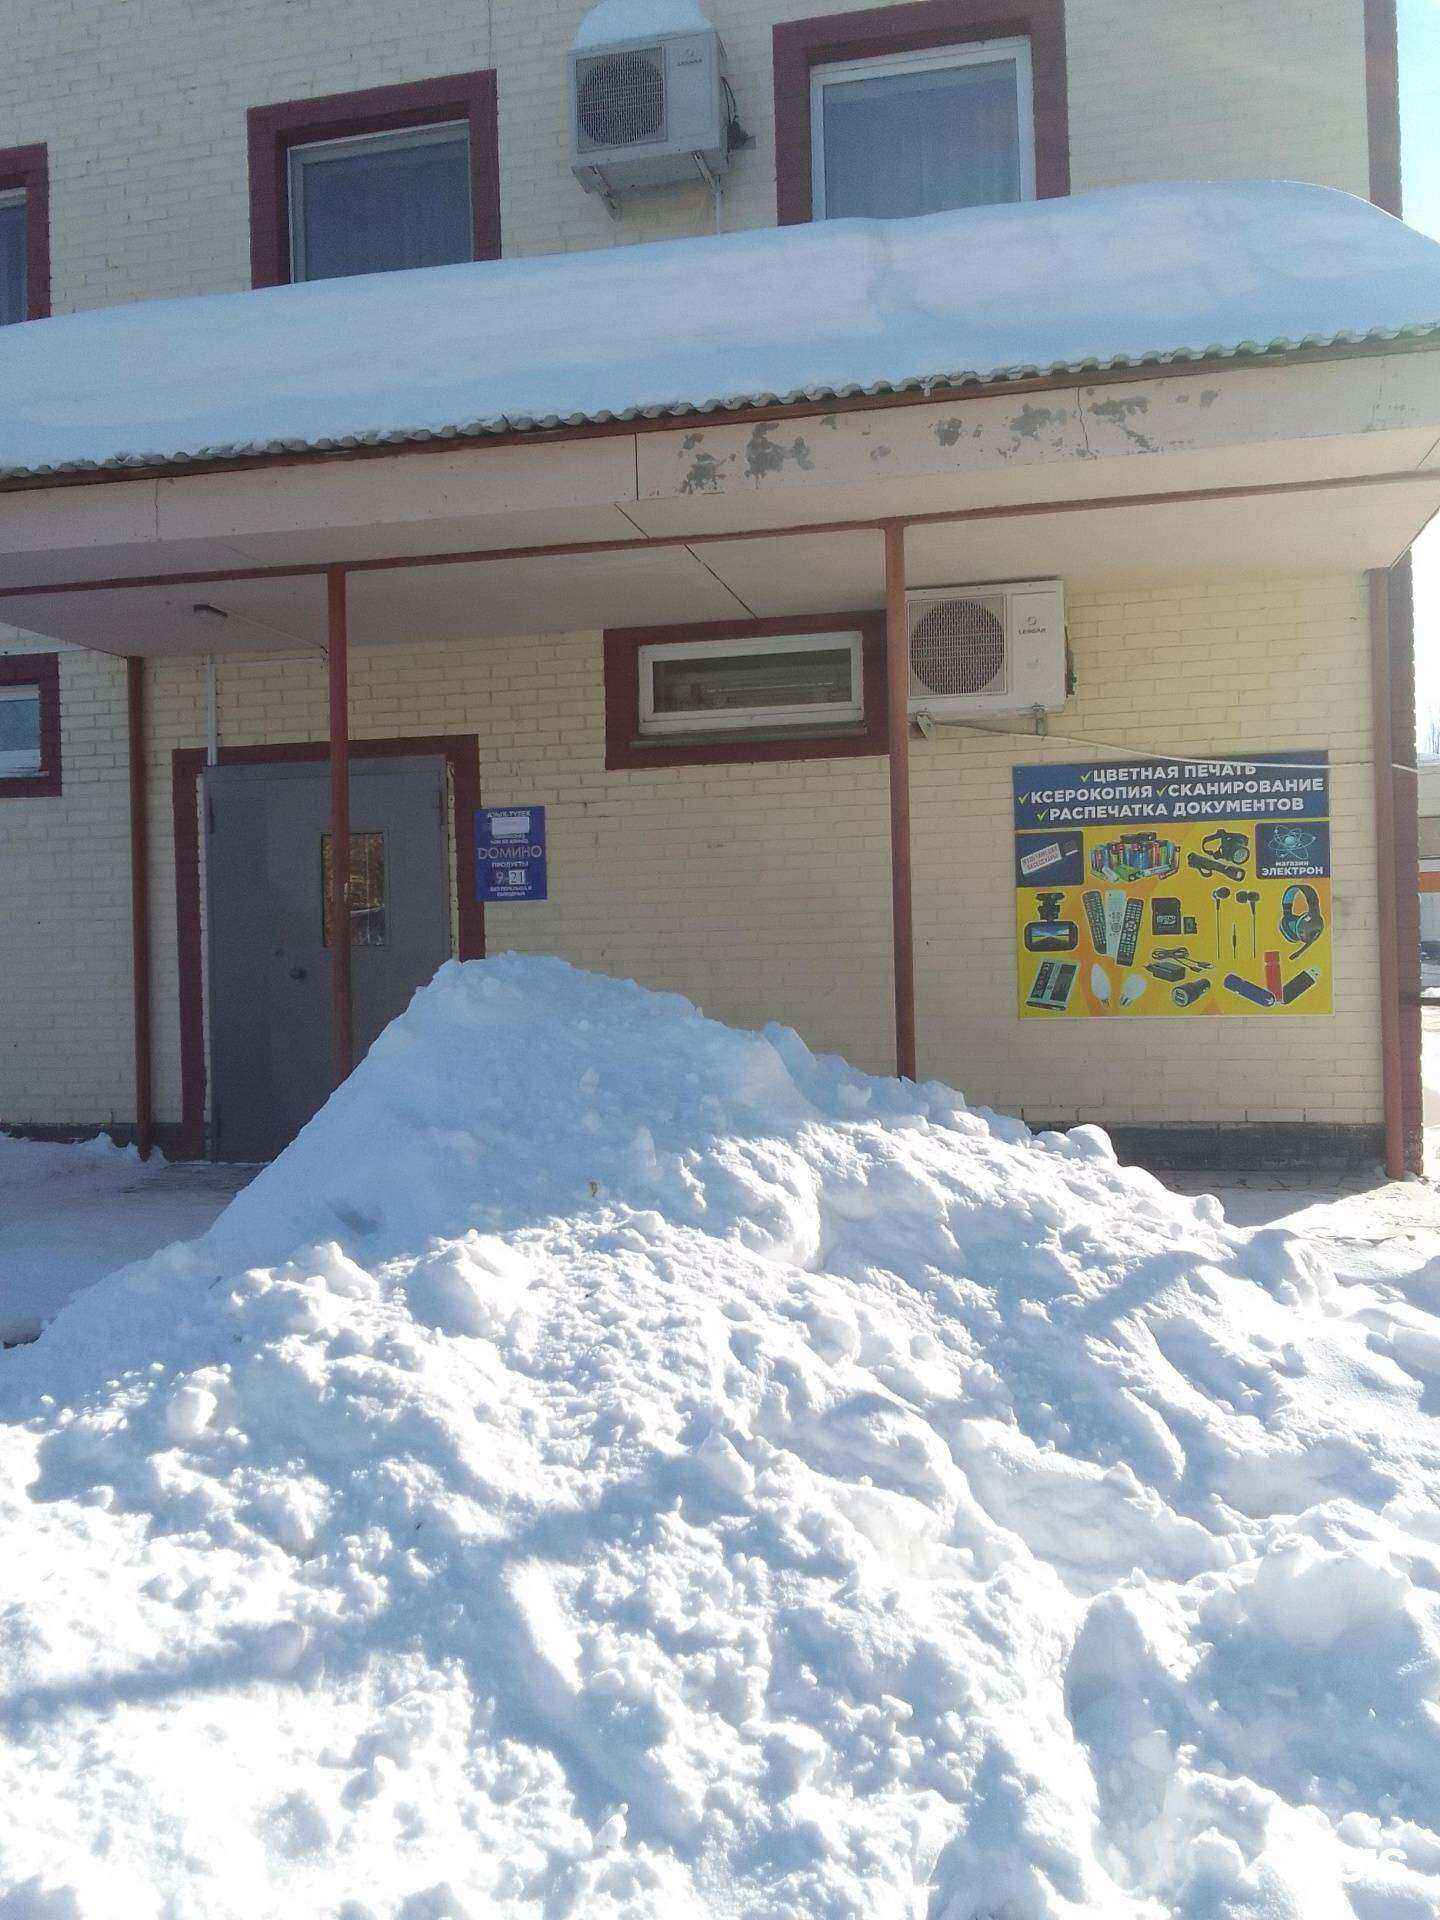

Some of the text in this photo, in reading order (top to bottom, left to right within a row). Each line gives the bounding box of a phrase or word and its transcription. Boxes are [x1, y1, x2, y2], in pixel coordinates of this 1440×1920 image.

[1093, 763, 1257, 783] ЦВЕТНАЯ ПЕЧАТЬ
[1031, 778, 1324, 804] КСЕРОКОПИЯ СКАНИРОВАНИЕ
[1049, 798, 1304, 821] РАСПЕЧАТКА ДОКУМЕНТОВ
[1262, 866, 1324, 876] ЭЛЕКТРОН
